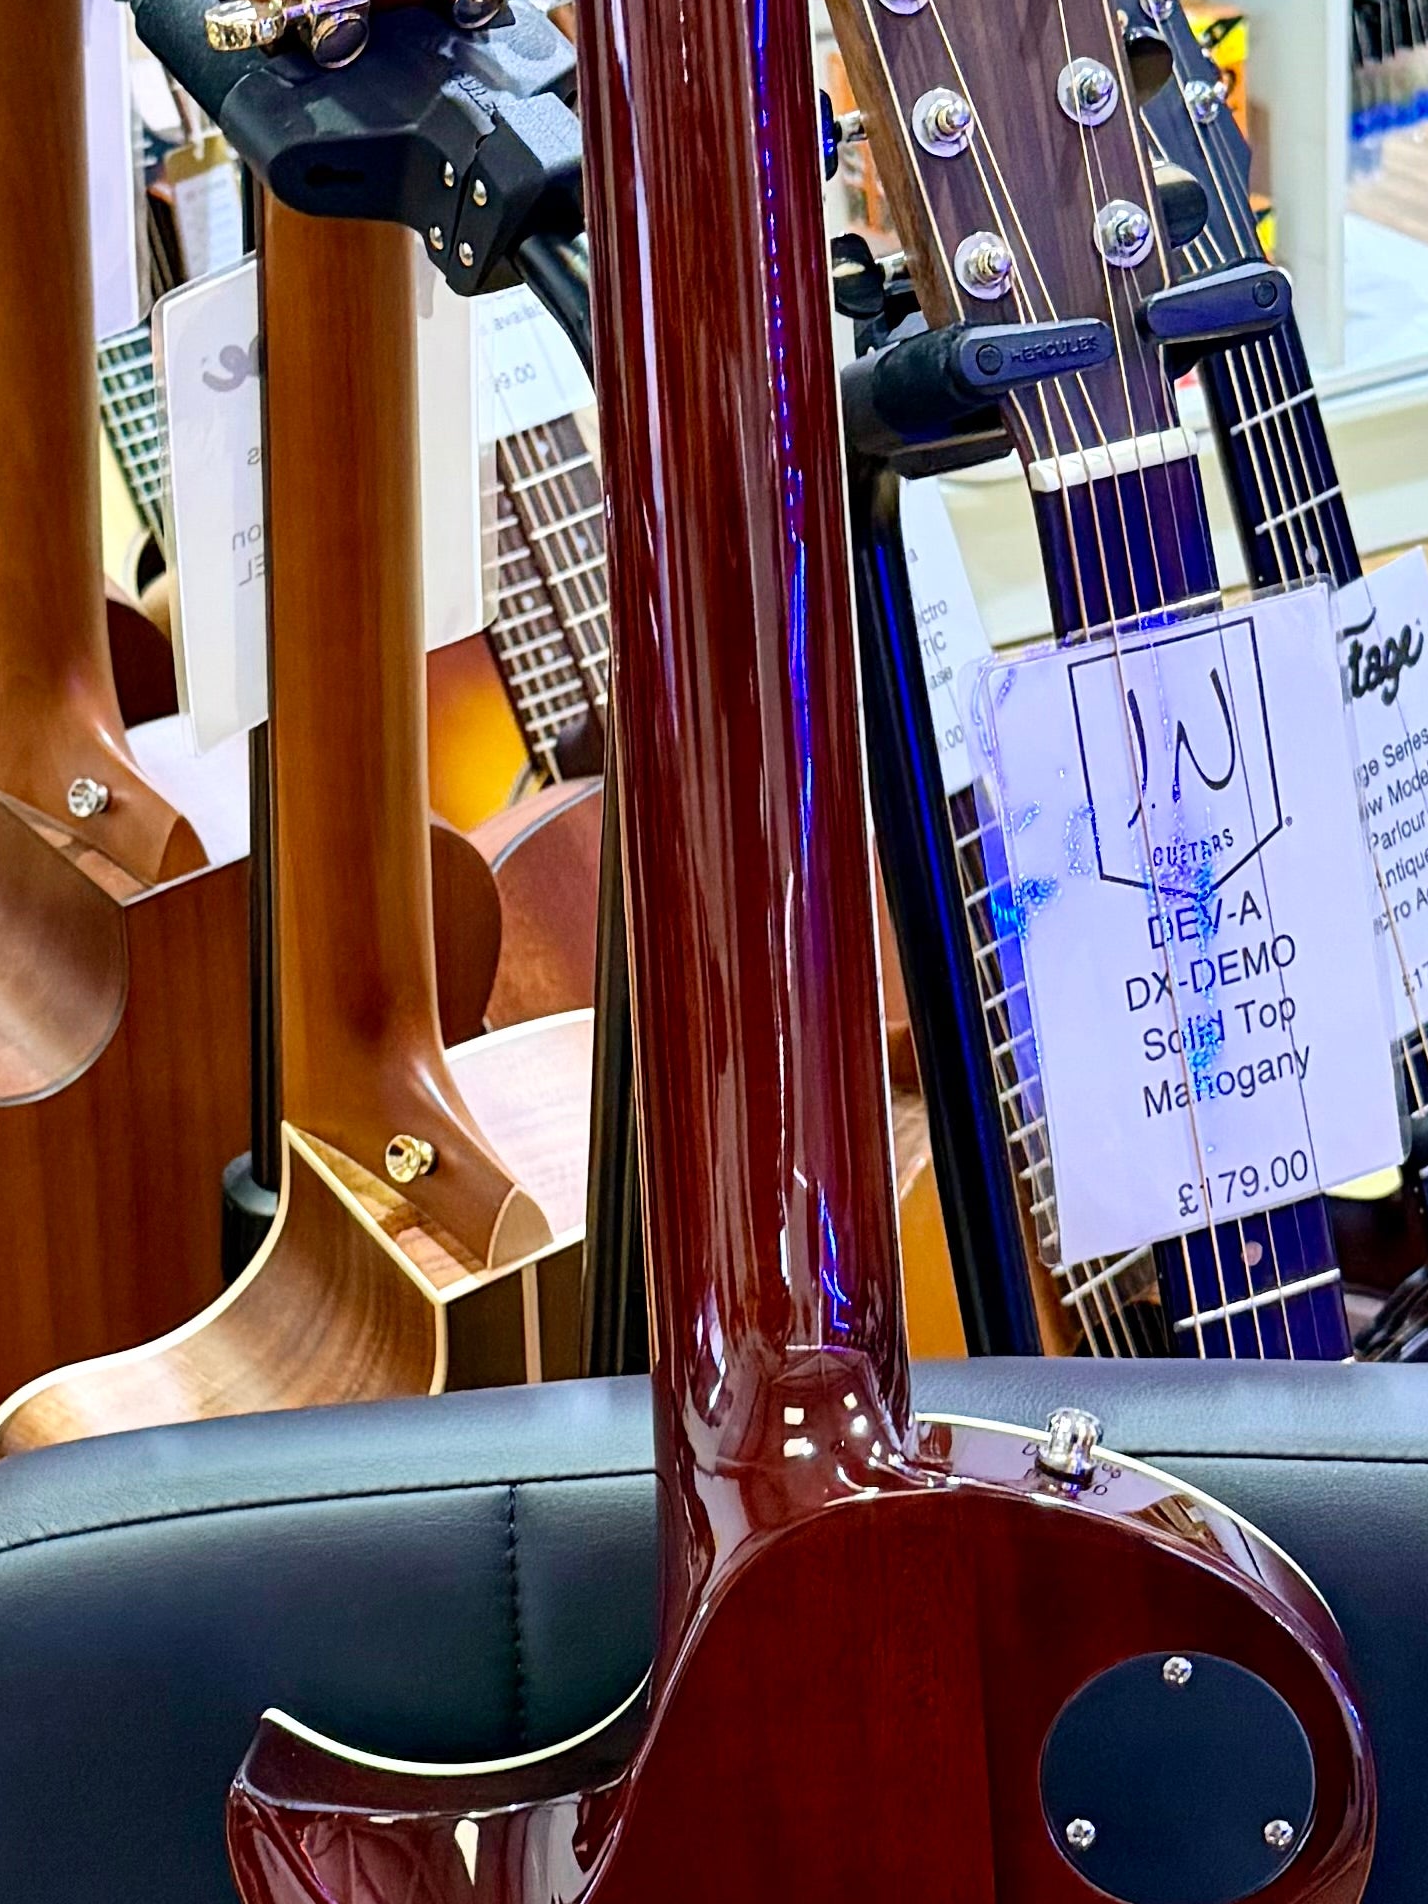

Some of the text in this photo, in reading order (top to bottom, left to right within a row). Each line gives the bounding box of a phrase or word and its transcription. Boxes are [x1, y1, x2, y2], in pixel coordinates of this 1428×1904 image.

[1012, 335, 1100, 362] HERCULES
[1147, 890, 1262, 950] DEV-A
[1125, 934, 1296, 1012] DX-DEMO
[1143, 997, 1296, 1062] Solid Top
[1142, 1045, 1310, 1118] Mahogany
[1177, 1149, 1309, 1217] £179.00
